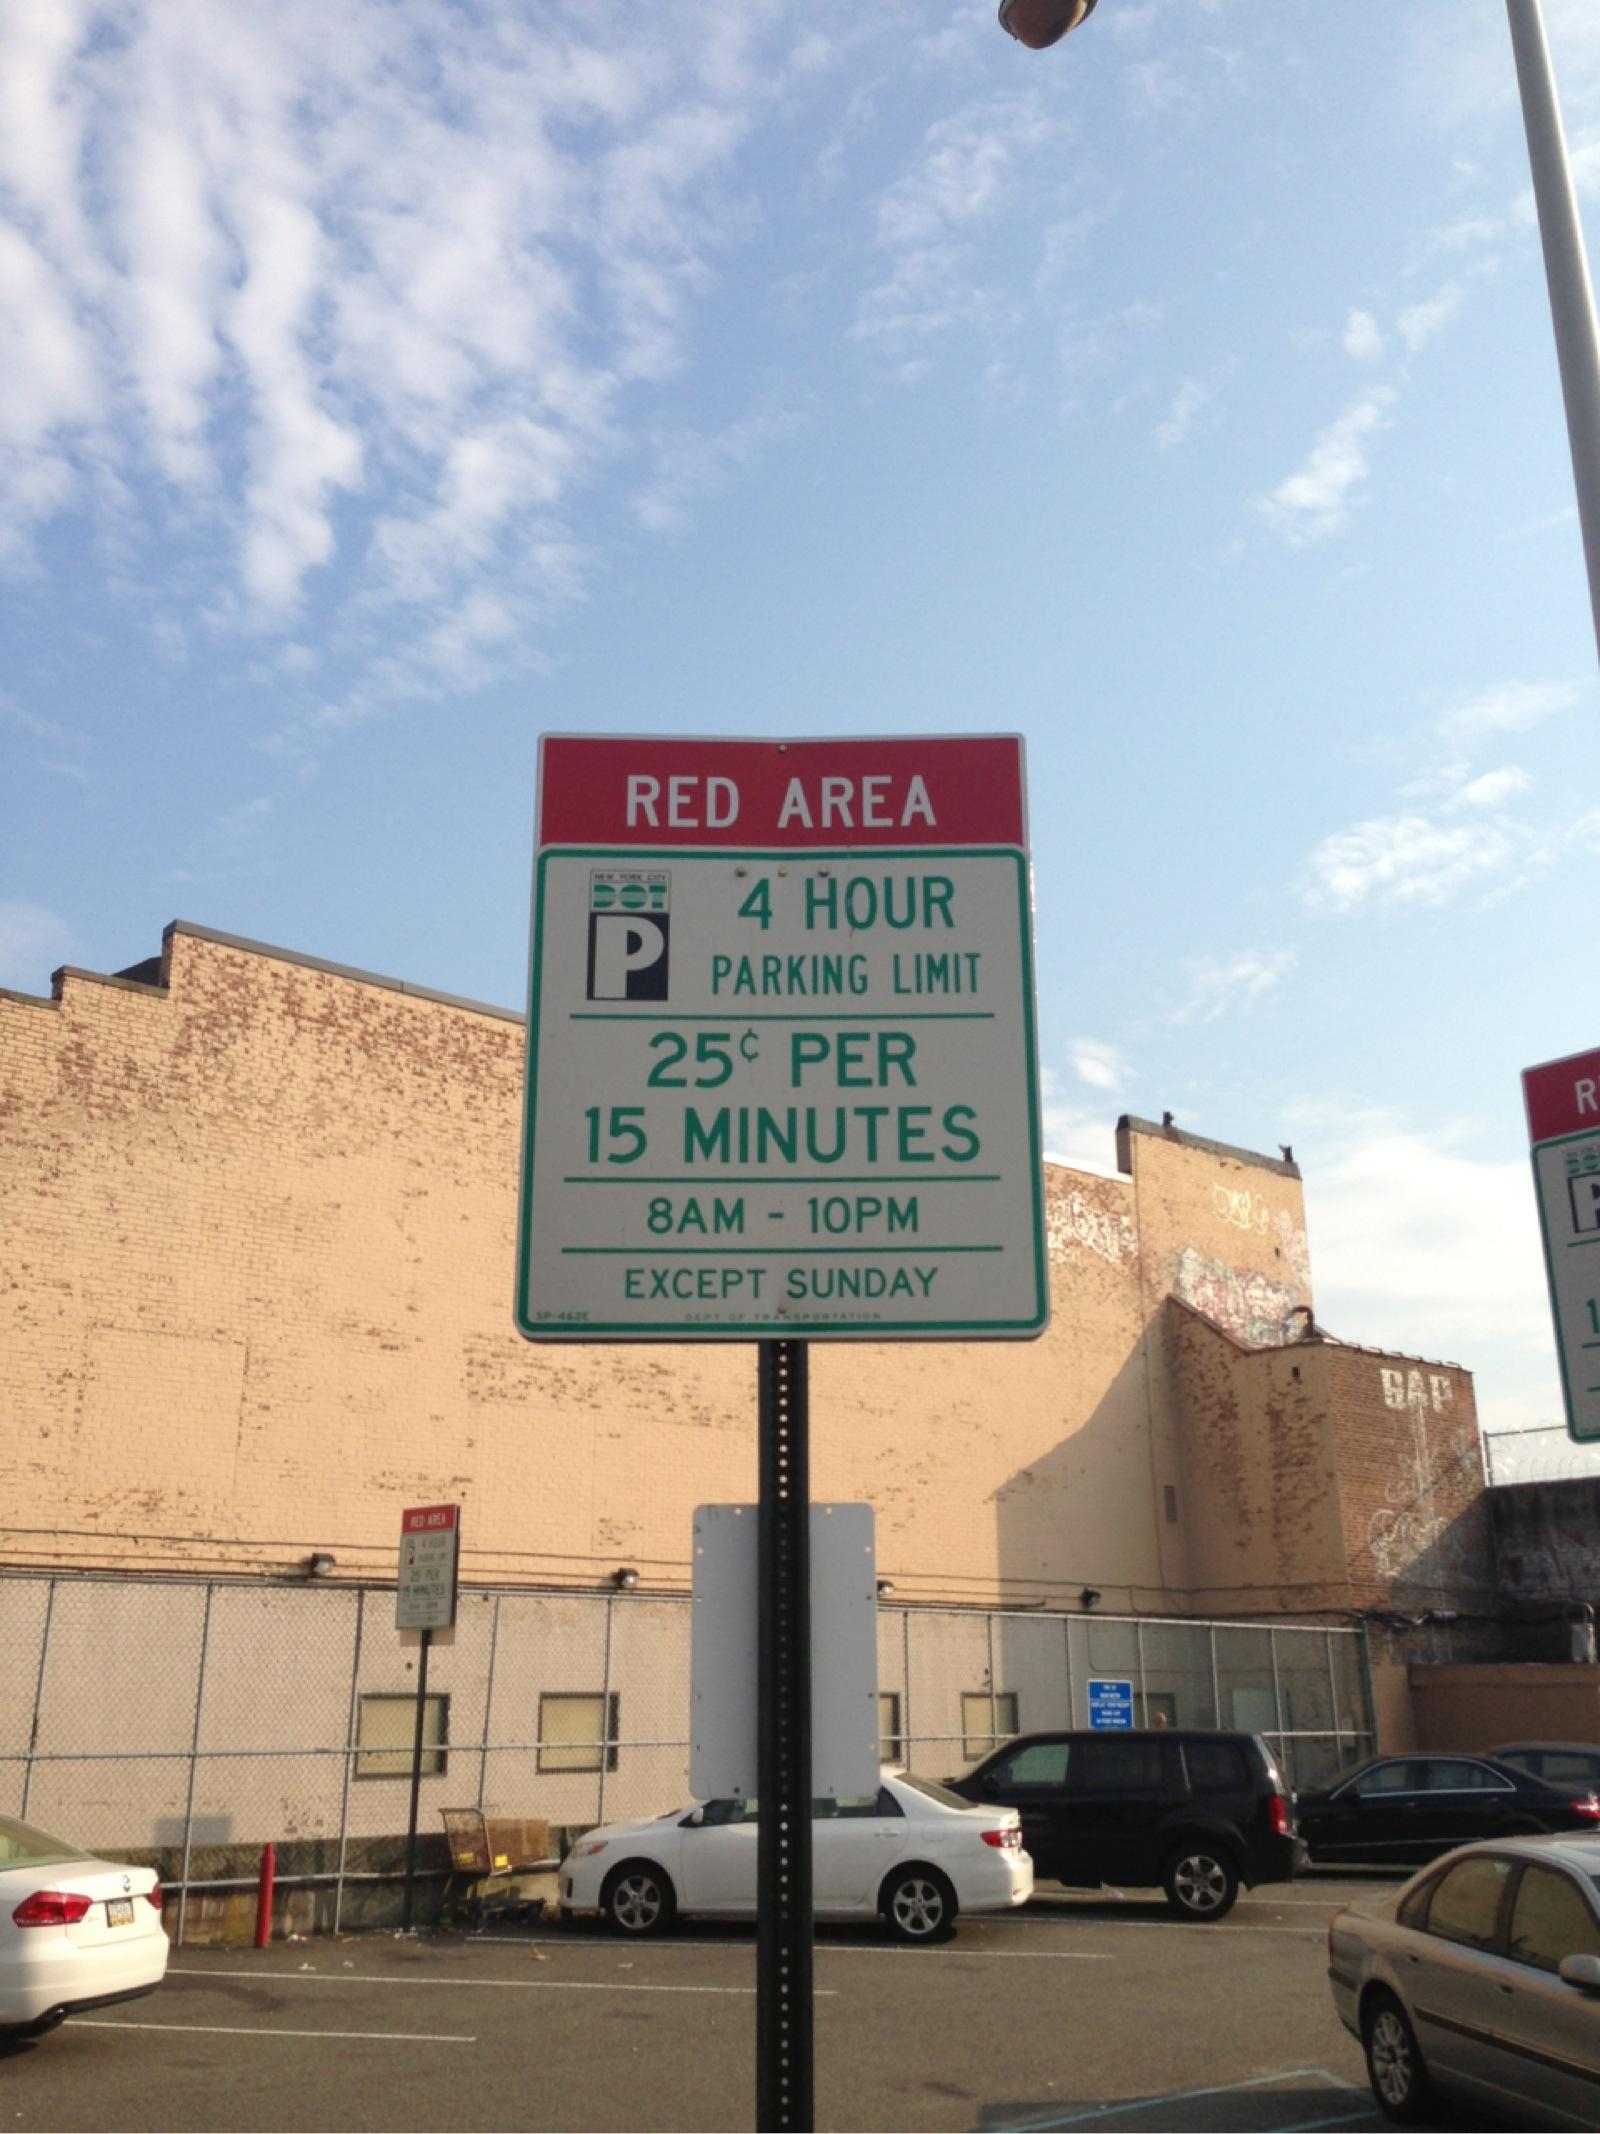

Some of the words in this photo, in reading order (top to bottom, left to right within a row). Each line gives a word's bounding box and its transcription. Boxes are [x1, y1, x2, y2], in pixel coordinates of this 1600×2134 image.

[626, 774, 740, 829] RED
[777, 774, 937, 829] AREA
[593, 883, 667, 909] DOT
[736, 877, 774, 931] 4
[804, 875, 956, 932] HOUR
[594, 915, 665, 999] P
[711, 952, 869, 997] PARKING
[892, 951, 981, 997] LIMIT
[790, 1031, 918, 1089] PER
[585, 1106, 648, 1165] 15
[683, 1103, 982, 1165] MINUTES
[646, 1196, 746, 1236] 8AM
[808, 1196, 920, 1235] 10PM
[624, 1268, 765, 1300] EXCEPT
[787, 1267, 938, 1300] SUNDAY
